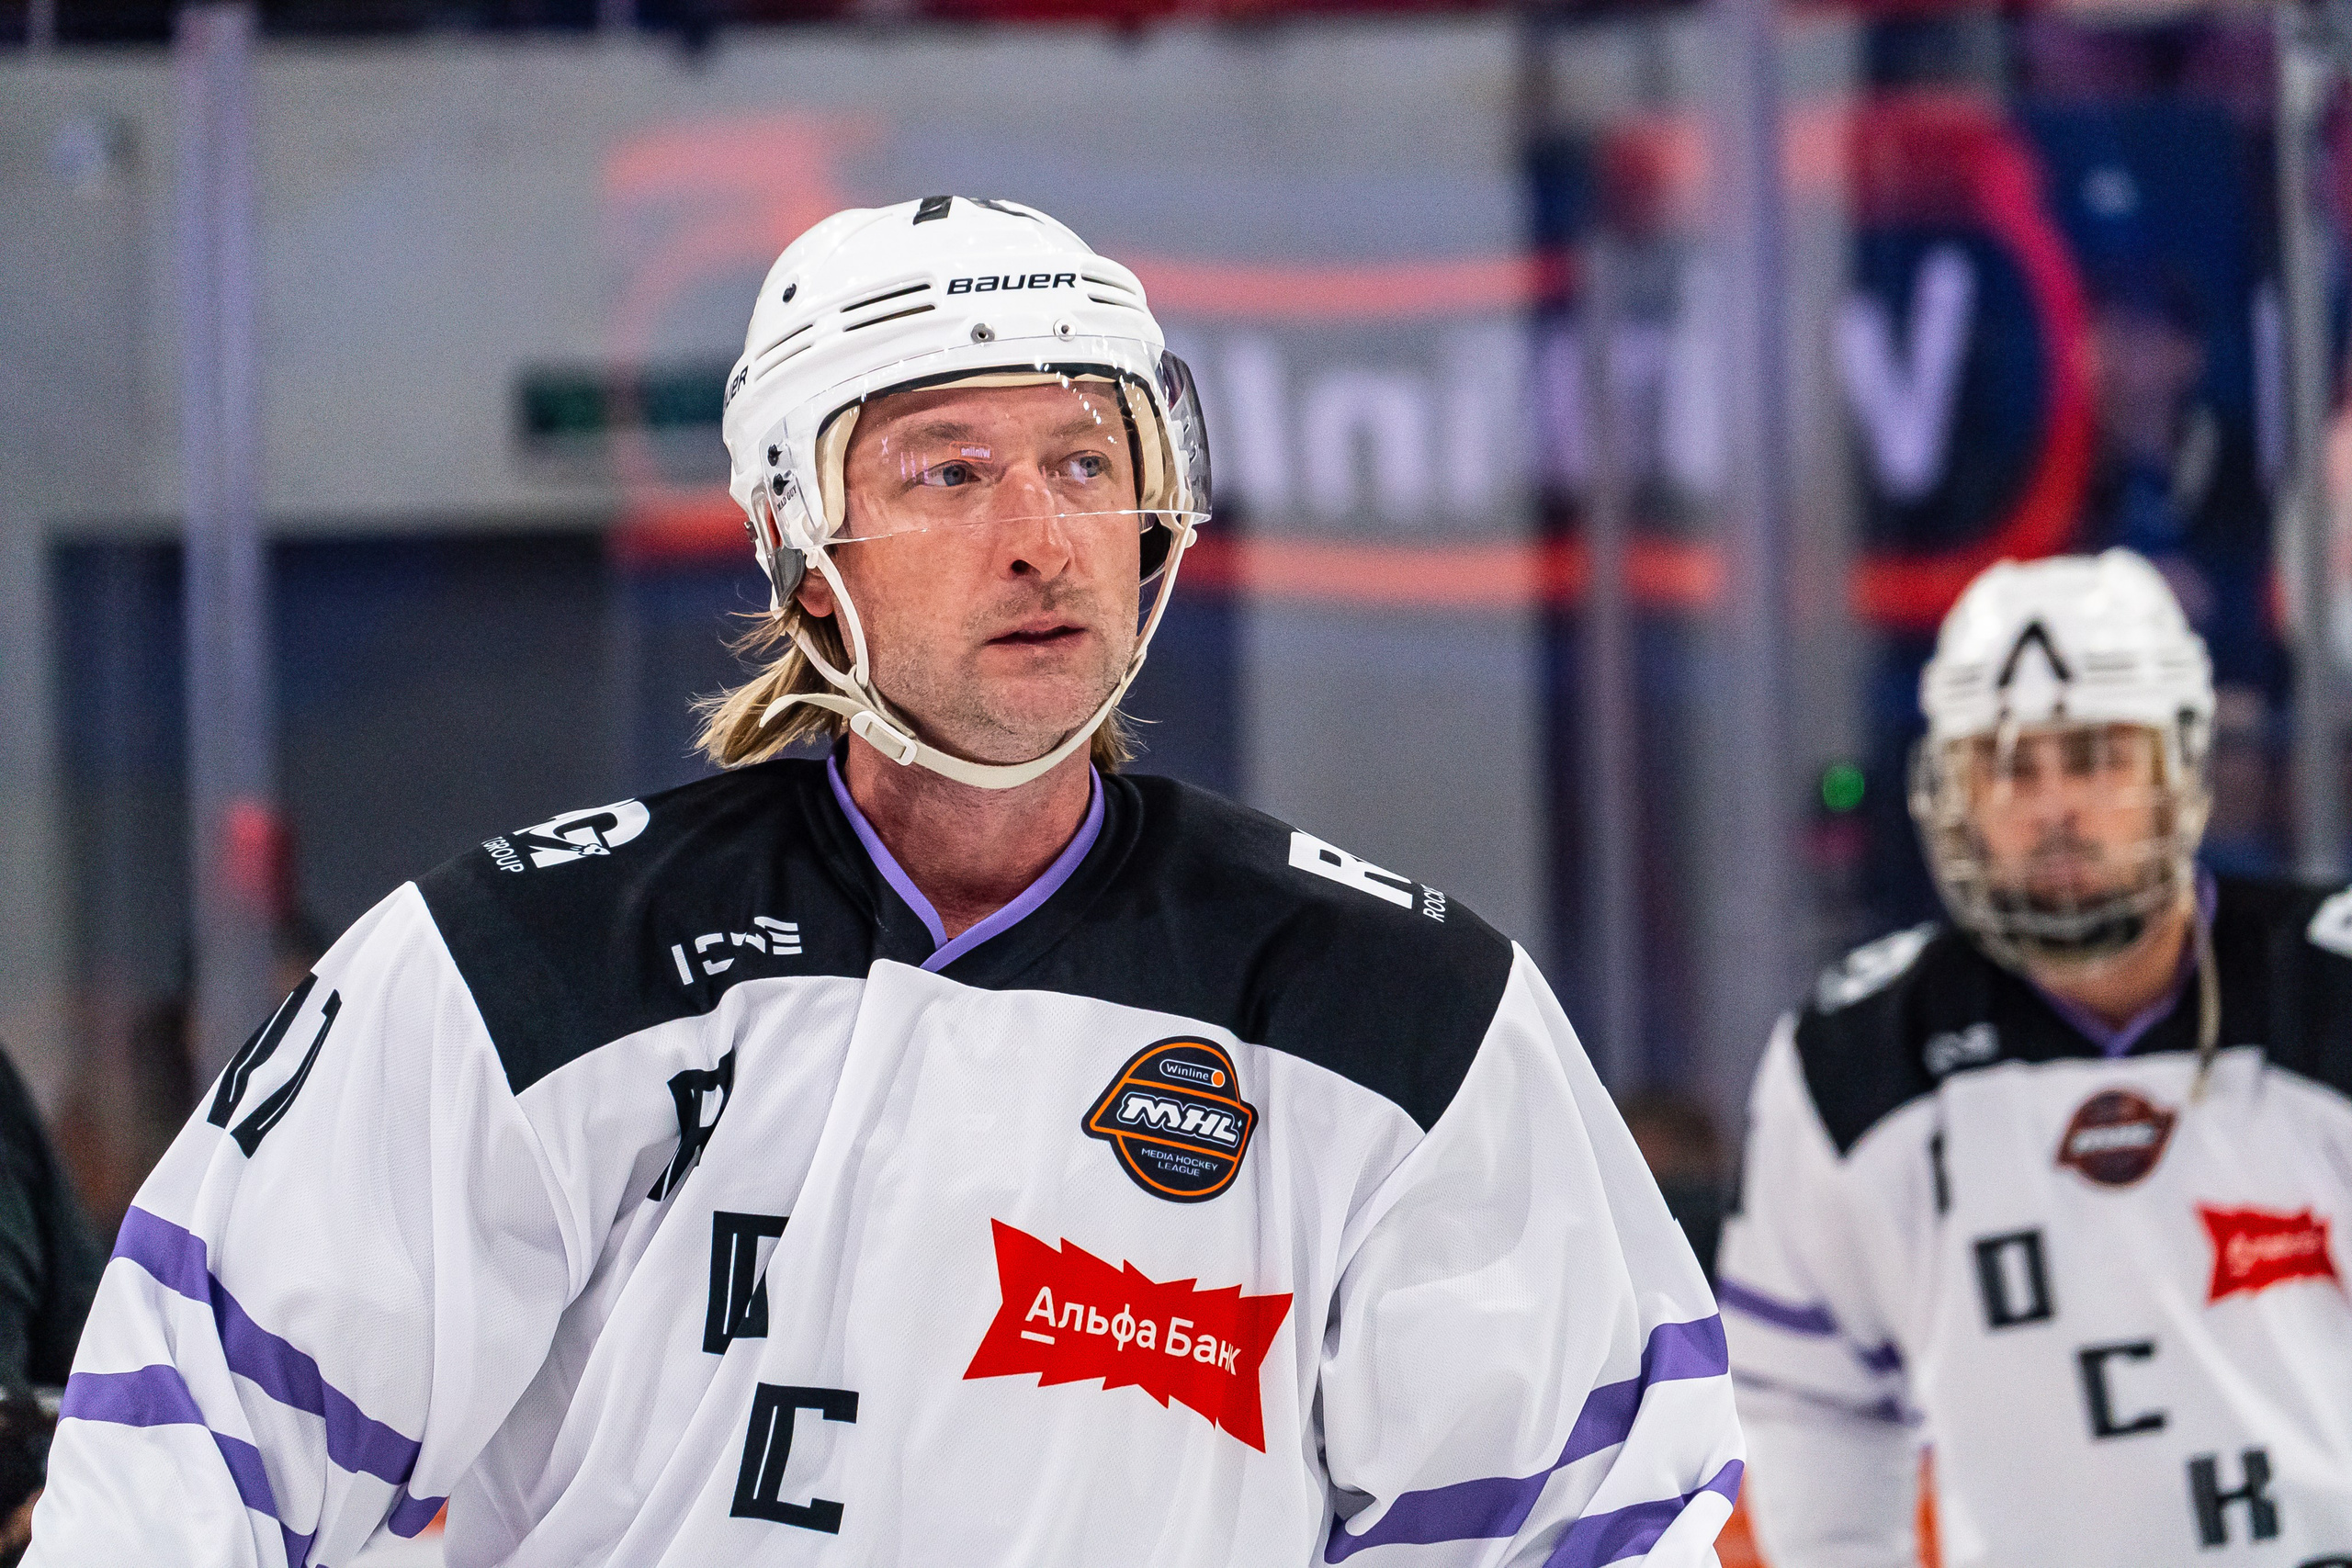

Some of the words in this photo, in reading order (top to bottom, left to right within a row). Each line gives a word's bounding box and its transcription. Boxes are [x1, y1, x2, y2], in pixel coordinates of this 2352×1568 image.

[1166, 1062, 1210, 1082] Winline
[1121, 1096, 1238, 1144] MHL
[1141, 1147, 1175, 1163] MEDIA
[1174, 1154, 1219, 1173] HOCKEY
[1158, 1160, 1201, 1178] LEAGUE
[1021, 1286, 1158, 1352] Альфа
[1164, 1315, 1242, 1376] Банк
